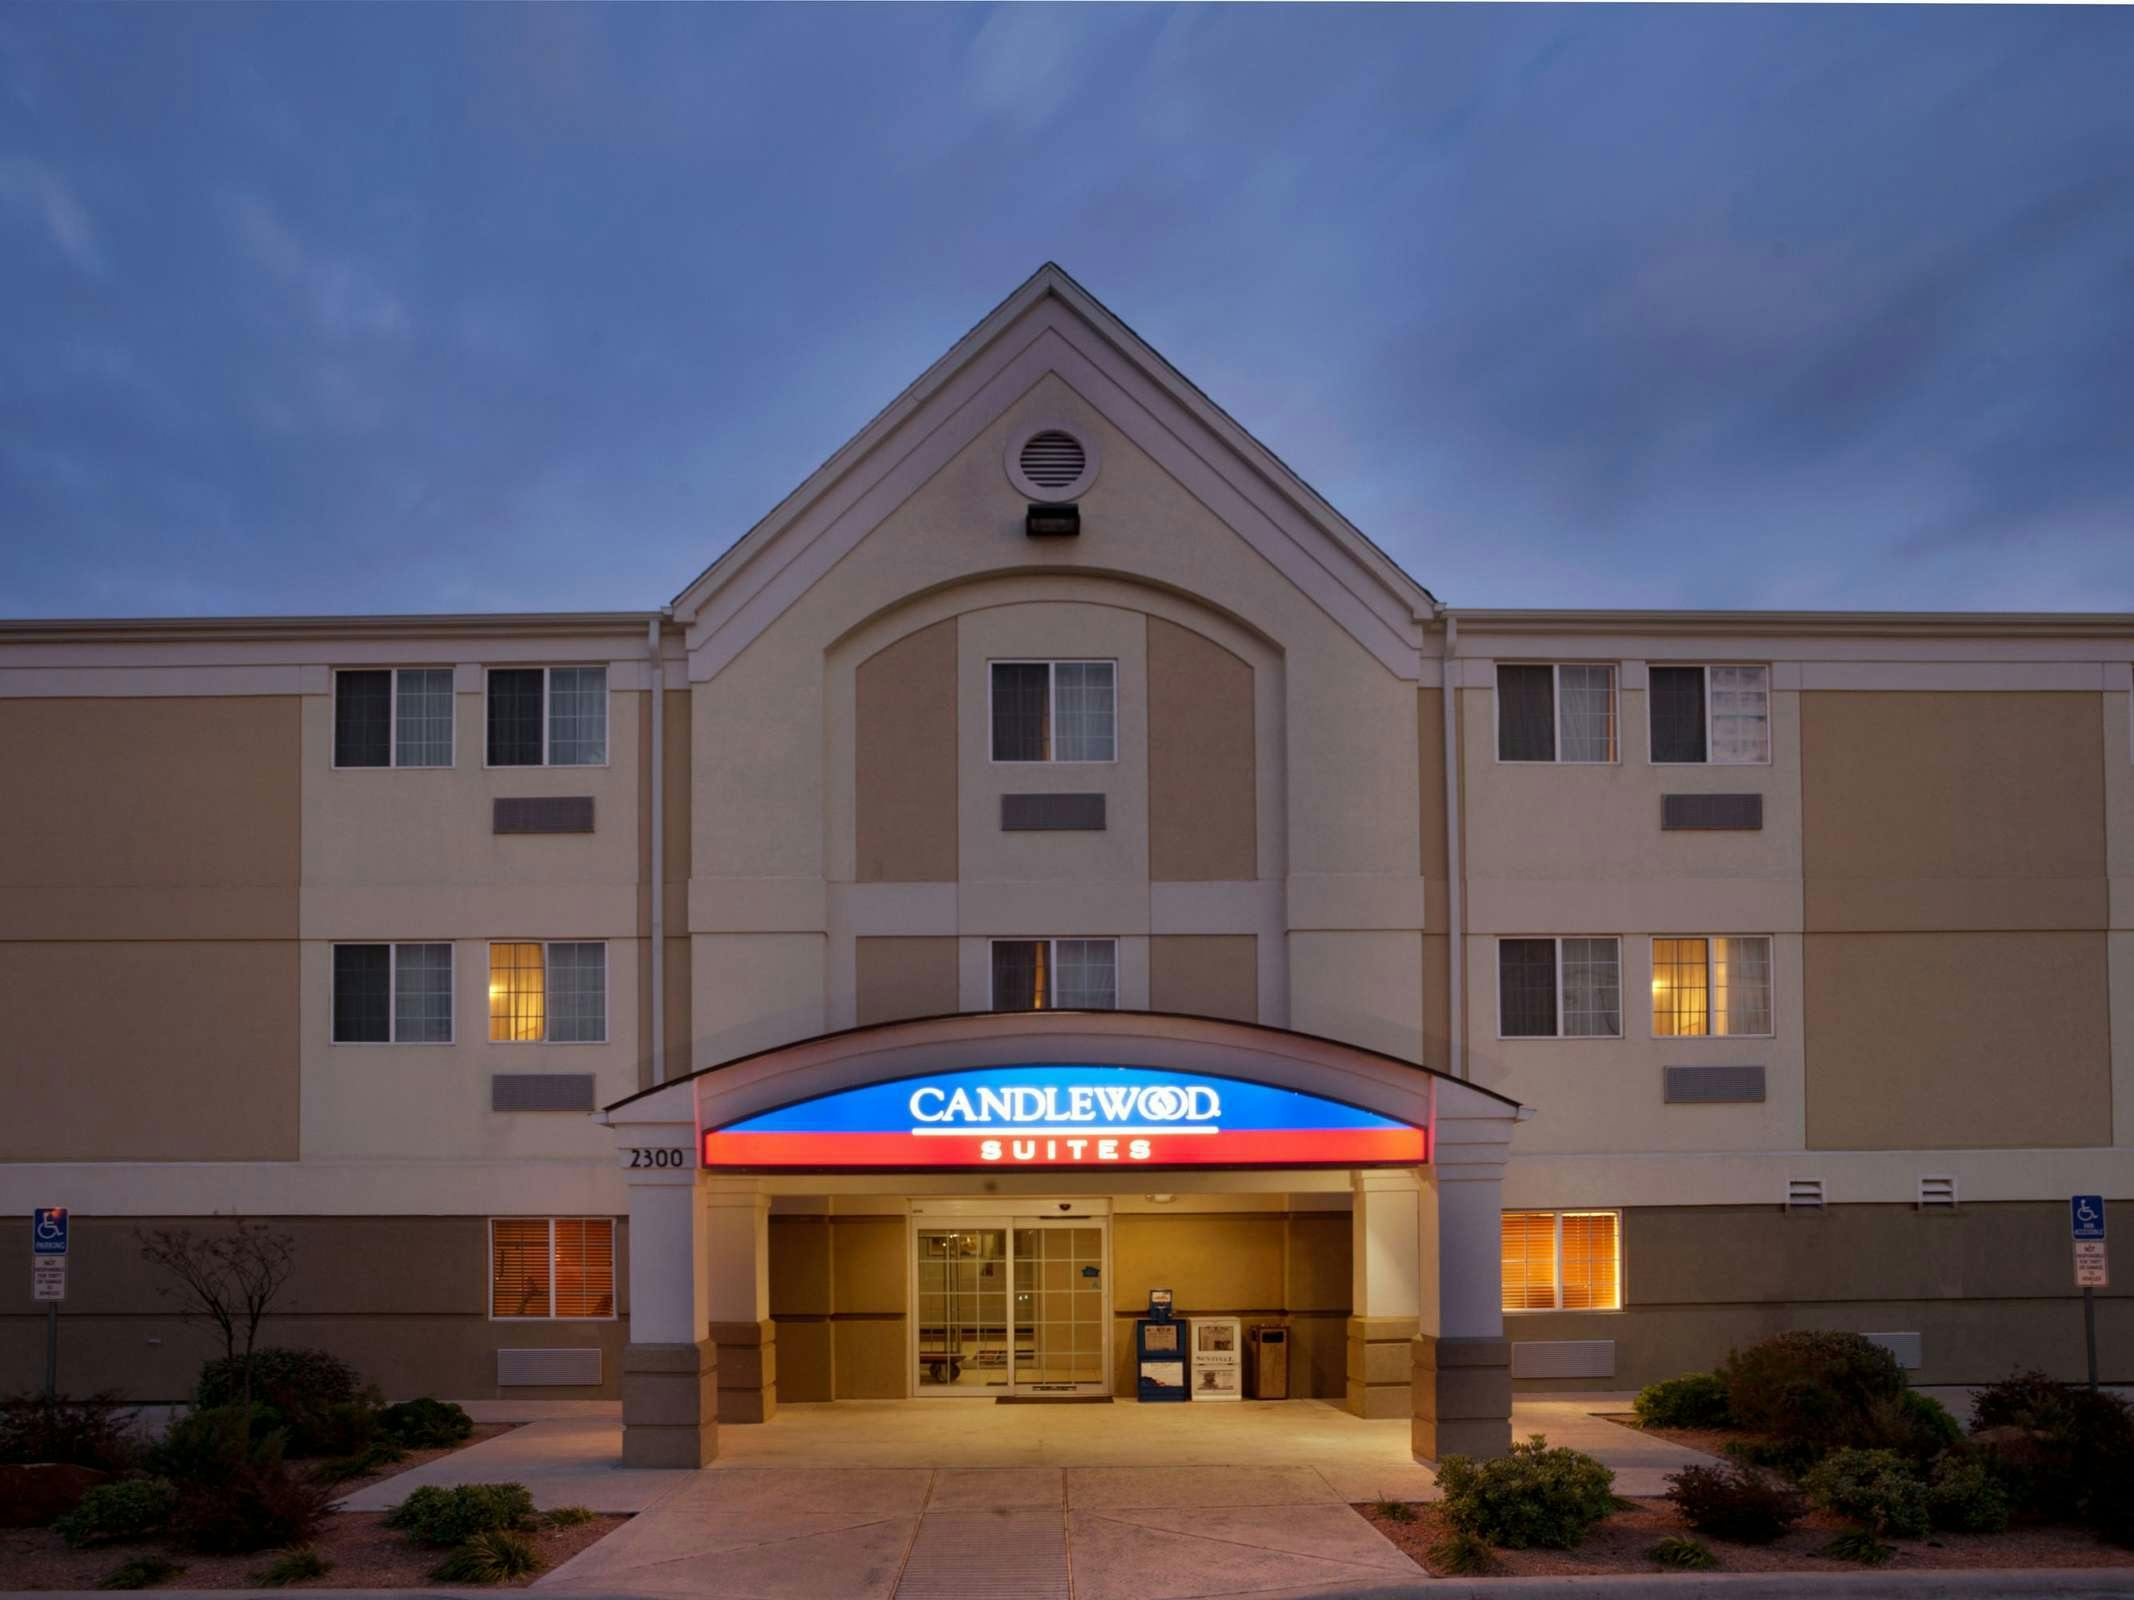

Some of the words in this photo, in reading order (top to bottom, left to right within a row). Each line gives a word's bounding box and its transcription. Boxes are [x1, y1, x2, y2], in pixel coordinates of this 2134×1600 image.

[908, 1085, 1221, 1122] CANDLEWOOD
[630, 1148, 684, 1168] 2300
[980, 1139, 1152, 1161] SUITES
